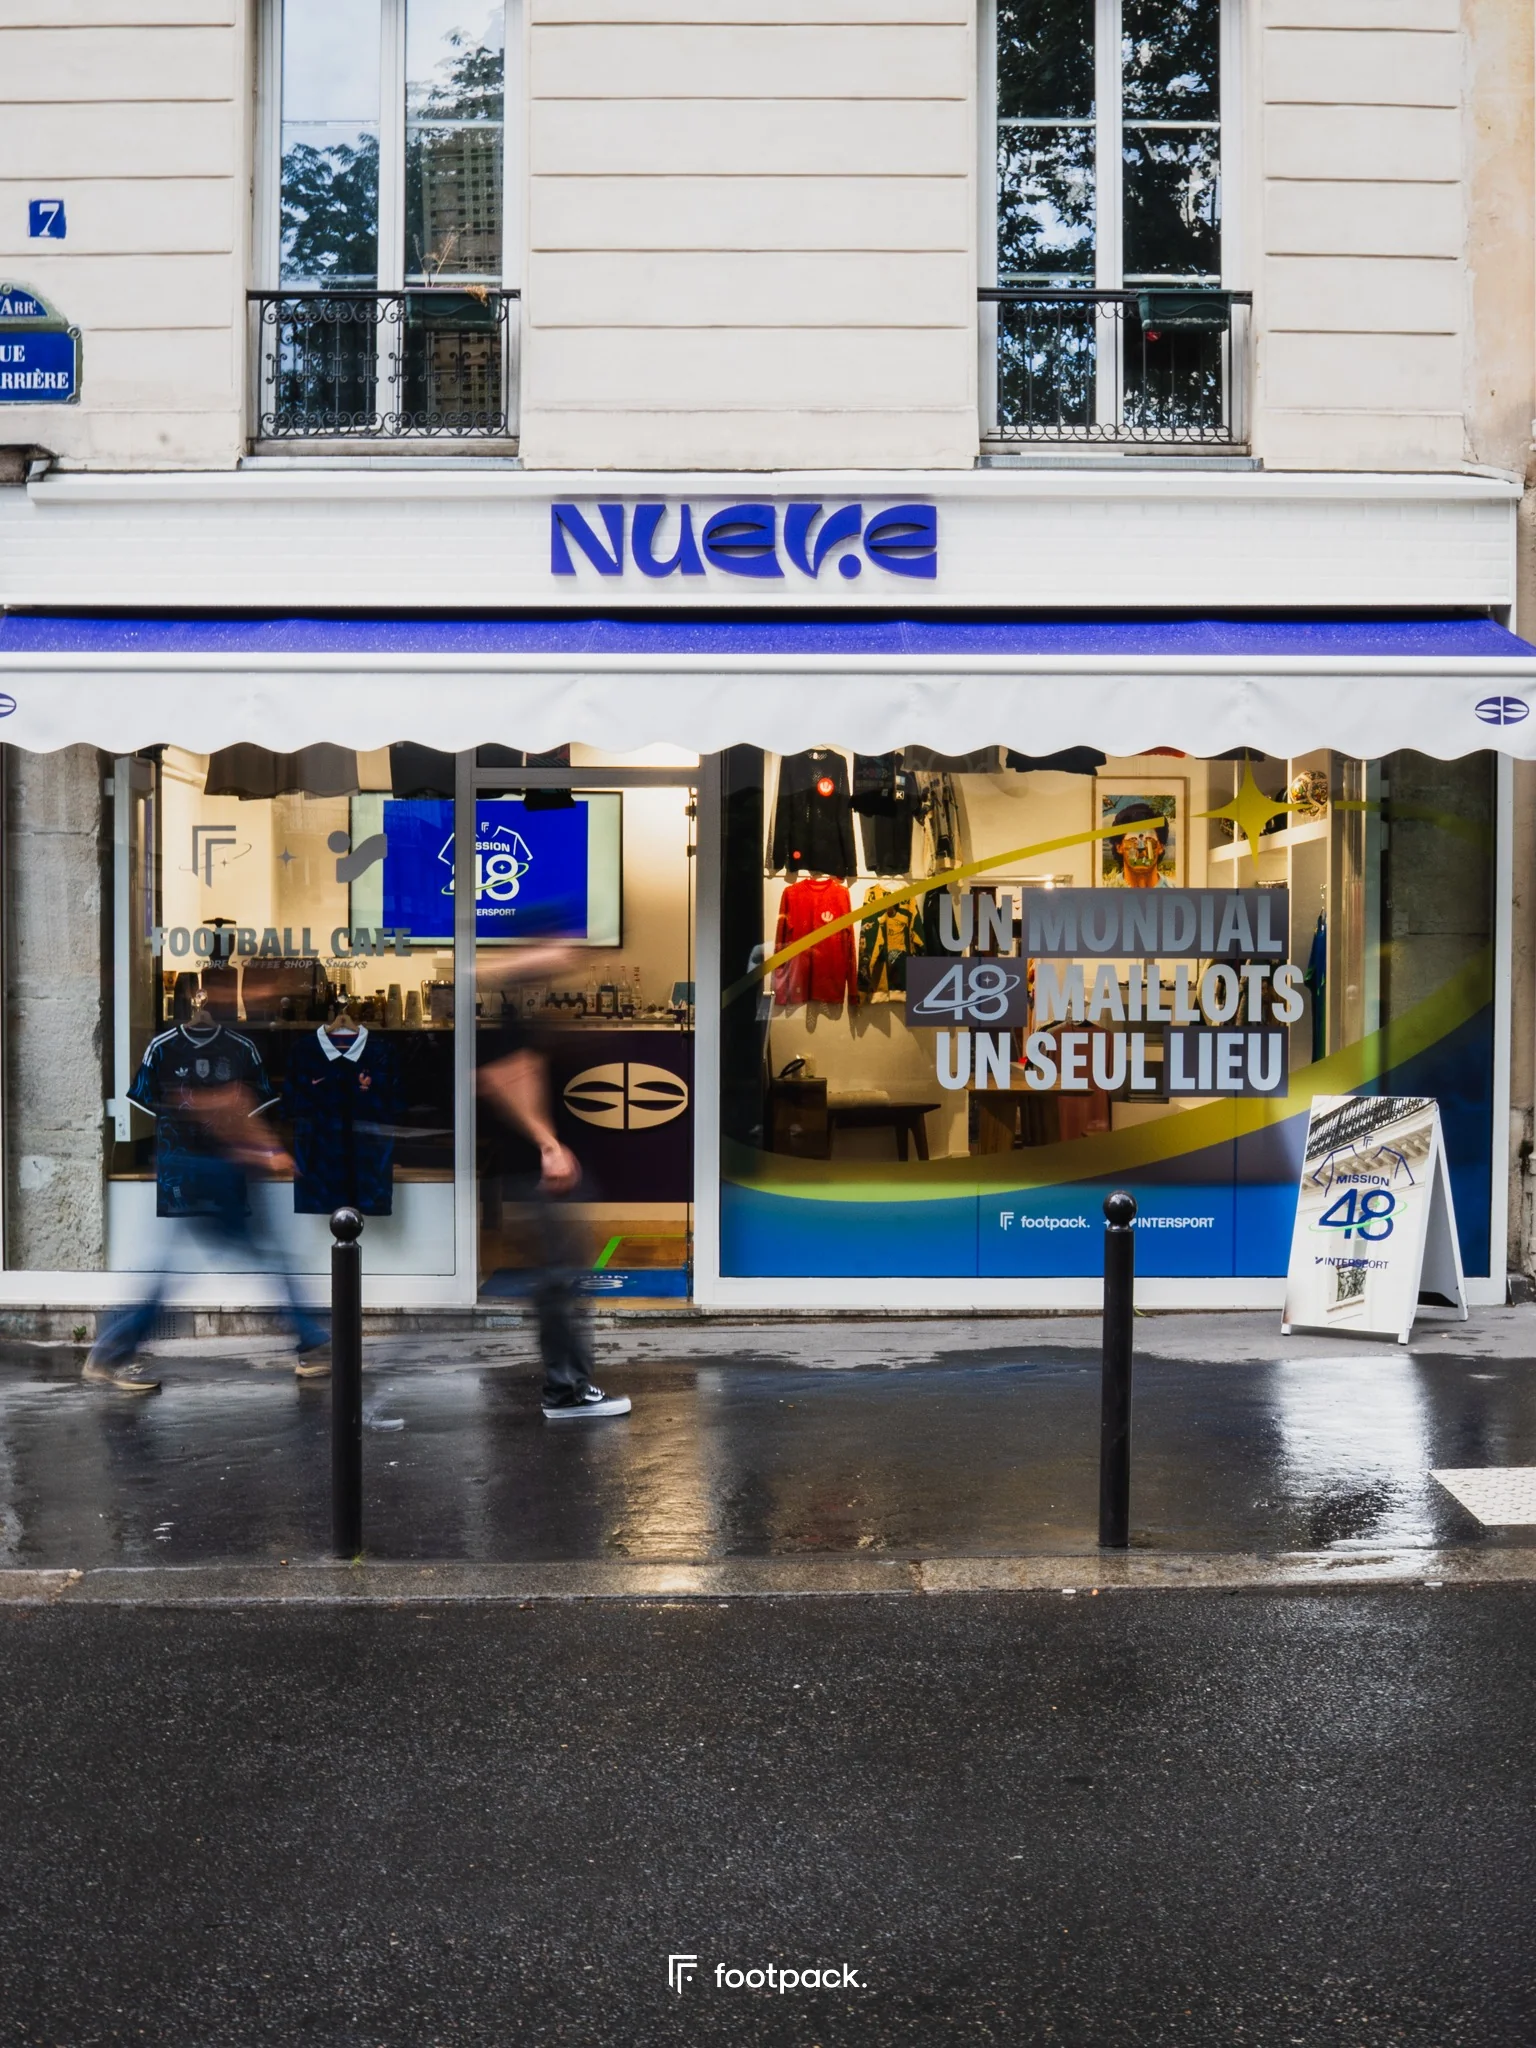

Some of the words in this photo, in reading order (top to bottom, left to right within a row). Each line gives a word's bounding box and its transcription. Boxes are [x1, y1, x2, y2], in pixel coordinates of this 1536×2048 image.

[39, 202, 59, 236] 7
[0, 345, 25, 362] UE
[0, 368, 69, 389] RRIÈRE
[475, 841, 510, 852] SSION
[476, 908, 516, 916] ERSPORT
[939, 894, 1013, 952] UN
[1028, 894, 1283, 952] MONDIAL
[151, 926, 320, 957] FOOTBALL
[330, 926, 412, 957] CAFE
[284, 960, 313, 969] SHOP
[923, 964, 1009, 1021] 48
[1036, 964, 1304, 1022] MAILLOTS
[936, 1032, 1011, 1090] UN
[1024, 1032, 1157, 1090] SEUL
[1170, 1032, 1282, 1090] LIEU
[1336, 1174, 1389, 1187] MISSION
[1021, 1215, 1091, 1231] footpack.
[1138, 1217, 1215, 1228] INTERSPORT
[1318, 1188, 1395, 1241] 48
[1324, 1257, 1389, 1270] INTERSPORT
